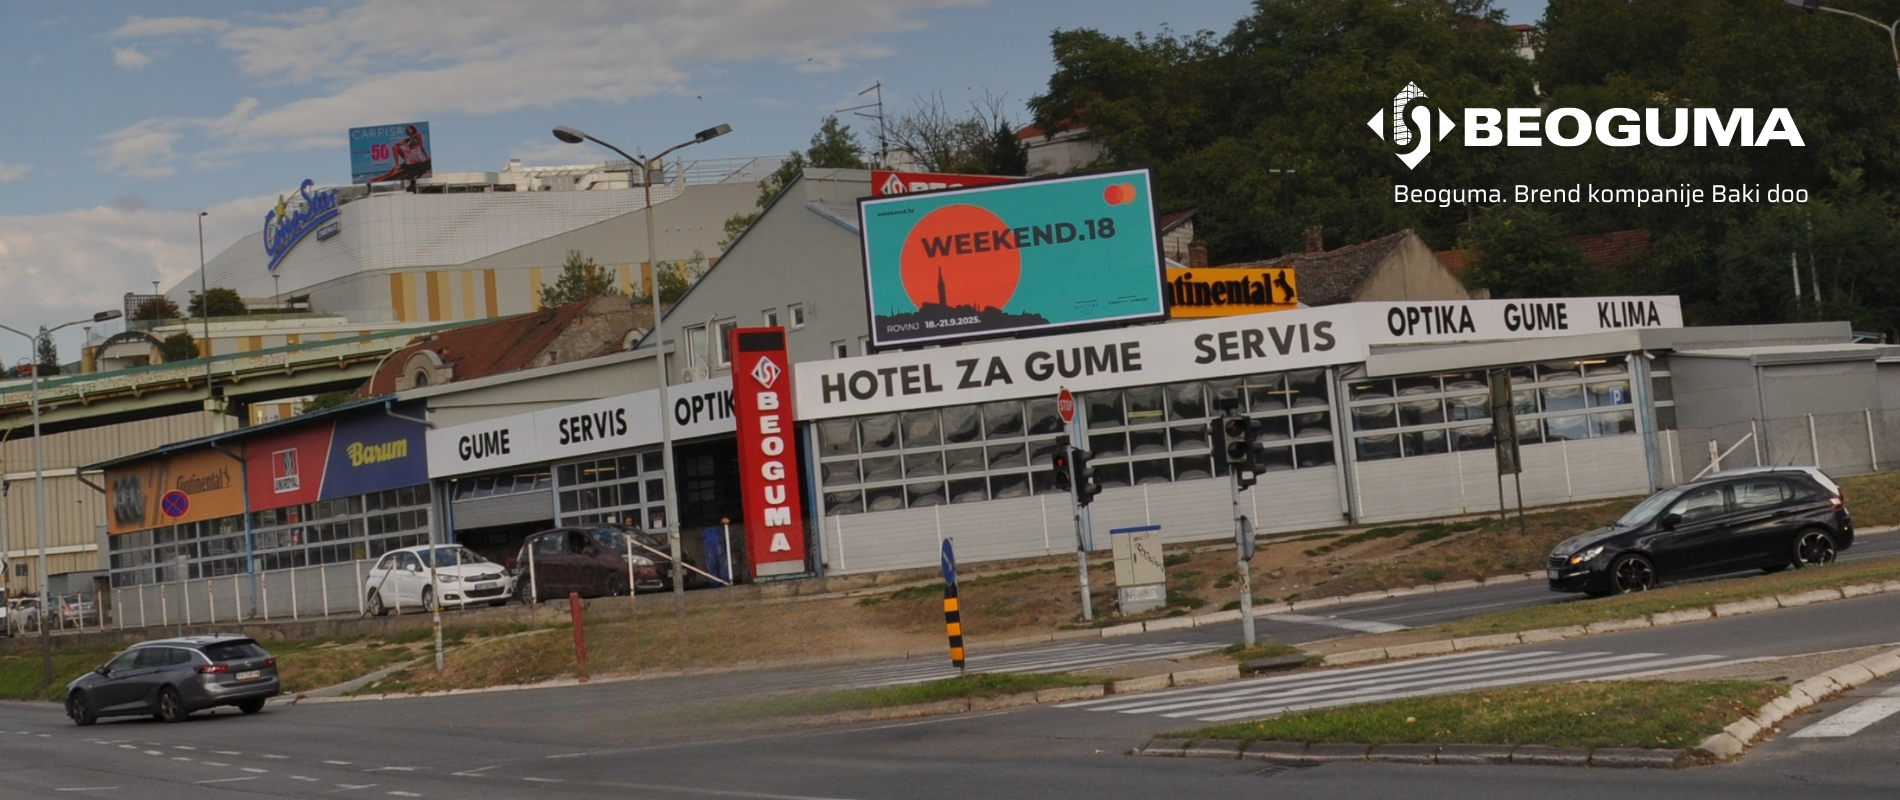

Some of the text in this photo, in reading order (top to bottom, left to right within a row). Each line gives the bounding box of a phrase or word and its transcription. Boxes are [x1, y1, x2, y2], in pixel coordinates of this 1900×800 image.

[352, 126, 404, 139] CARPISA
[371, 143, 389, 160] 50
[921, 217, 1116, 258] WEEKEND.18
[887, 316, 981, 333] ROVINJ 18.-21.9.2025.
[1387, 300, 1661, 336] OPTIKA GUME KLIMA
[821, 321, 1336, 403] HOTEL ZA GUME SERVIS
[1060, 399, 1073, 411] STOP
[459, 429, 510, 461] GUME
[559, 408, 628, 445] SERVIS
[346, 438, 407, 467] Barum
[757, 391, 791, 552] BEOGUMA
